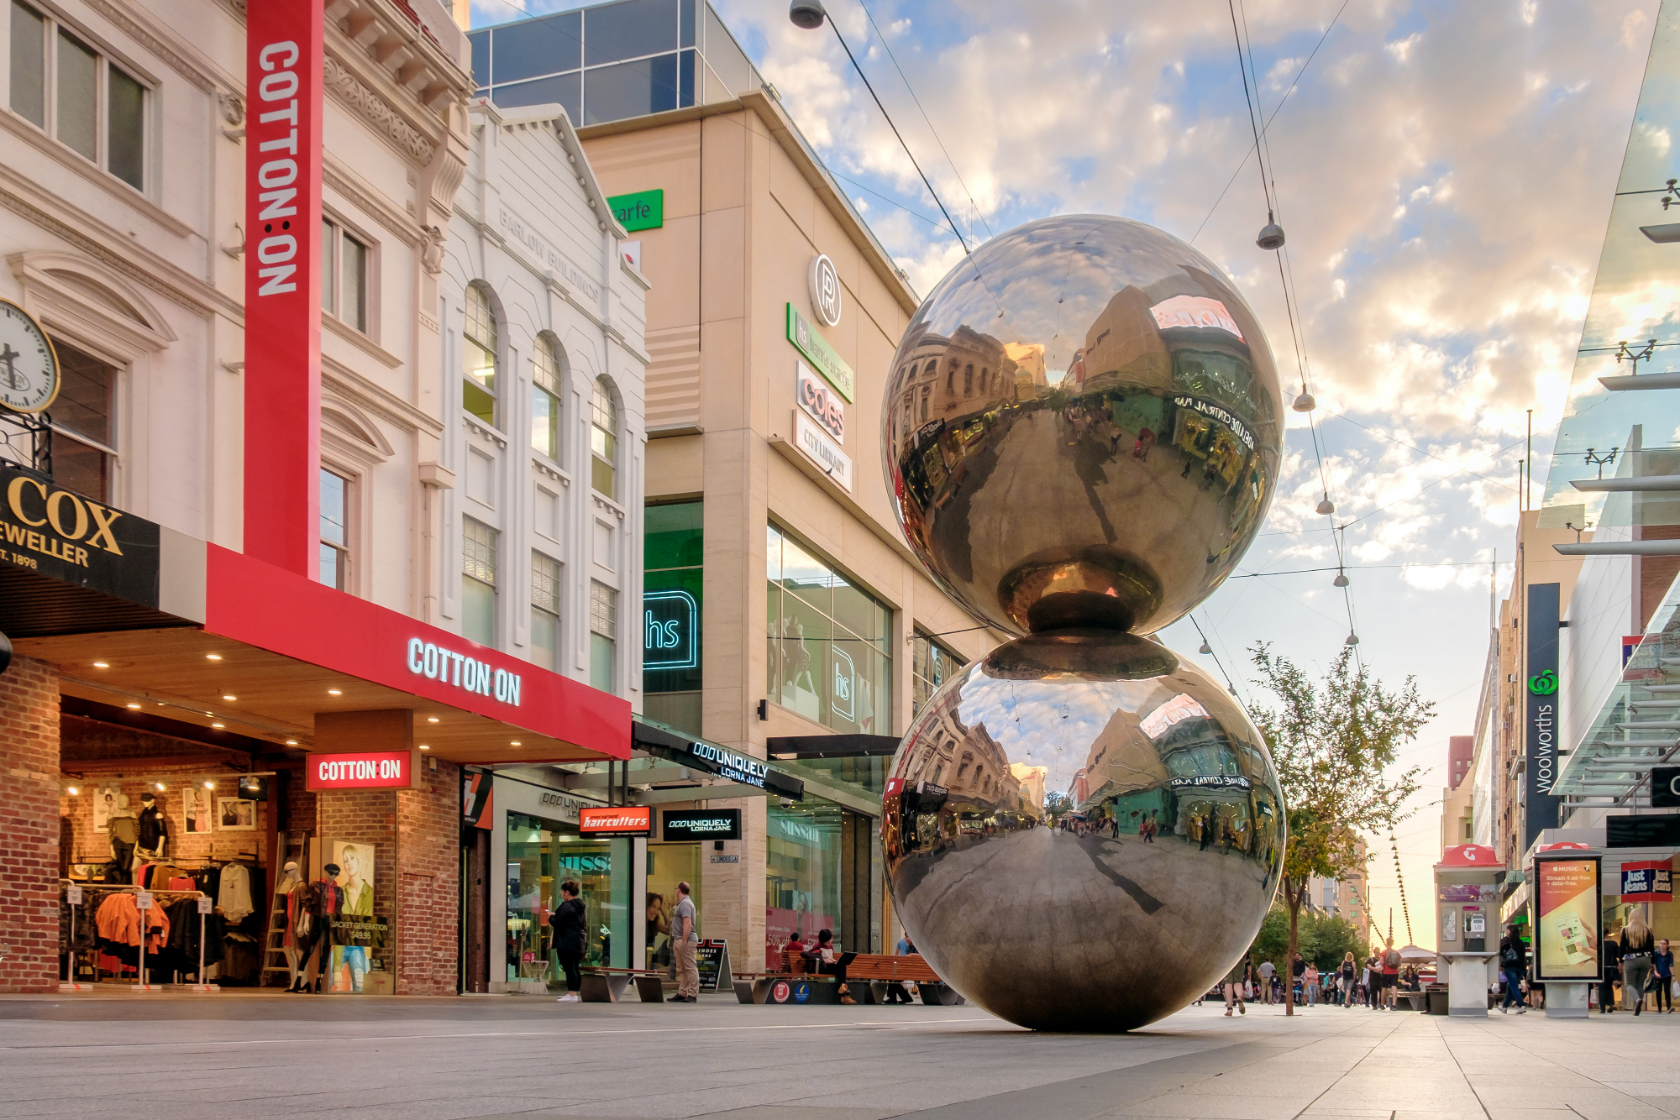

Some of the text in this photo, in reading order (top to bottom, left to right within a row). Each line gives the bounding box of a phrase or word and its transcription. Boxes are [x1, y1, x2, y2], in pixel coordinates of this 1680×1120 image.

[499, 207, 598, 303] BARLOW BUILDINGS
[803, 378, 844, 436] coles
[804, 428, 845, 477] CITY LIBRARY
[7, 476, 124, 557] COX
[12, 552, 37, 570] 1898
[645, 610, 679, 649] hs
[835, 661, 849, 701] hs
[1534, 703, 1552, 793] Woolworths
[716, 749, 768, 778] UNIQUELY
[721, 766, 745, 782] LORNA
[746, 775, 764, 788] JANE
[583, 816, 648, 828] haircutters
[687, 819, 731, 827] UNIQUELY
[780, 819, 819, 842] sussan
[1627, 869, 1645, 882] Just
[1652, 879, 1671, 893] Jeans
[1655, 869, 1669, 881] Just
[1623, 881, 1648, 894] Jeans
[332, 921, 388, 931] JACKET GENERATION
